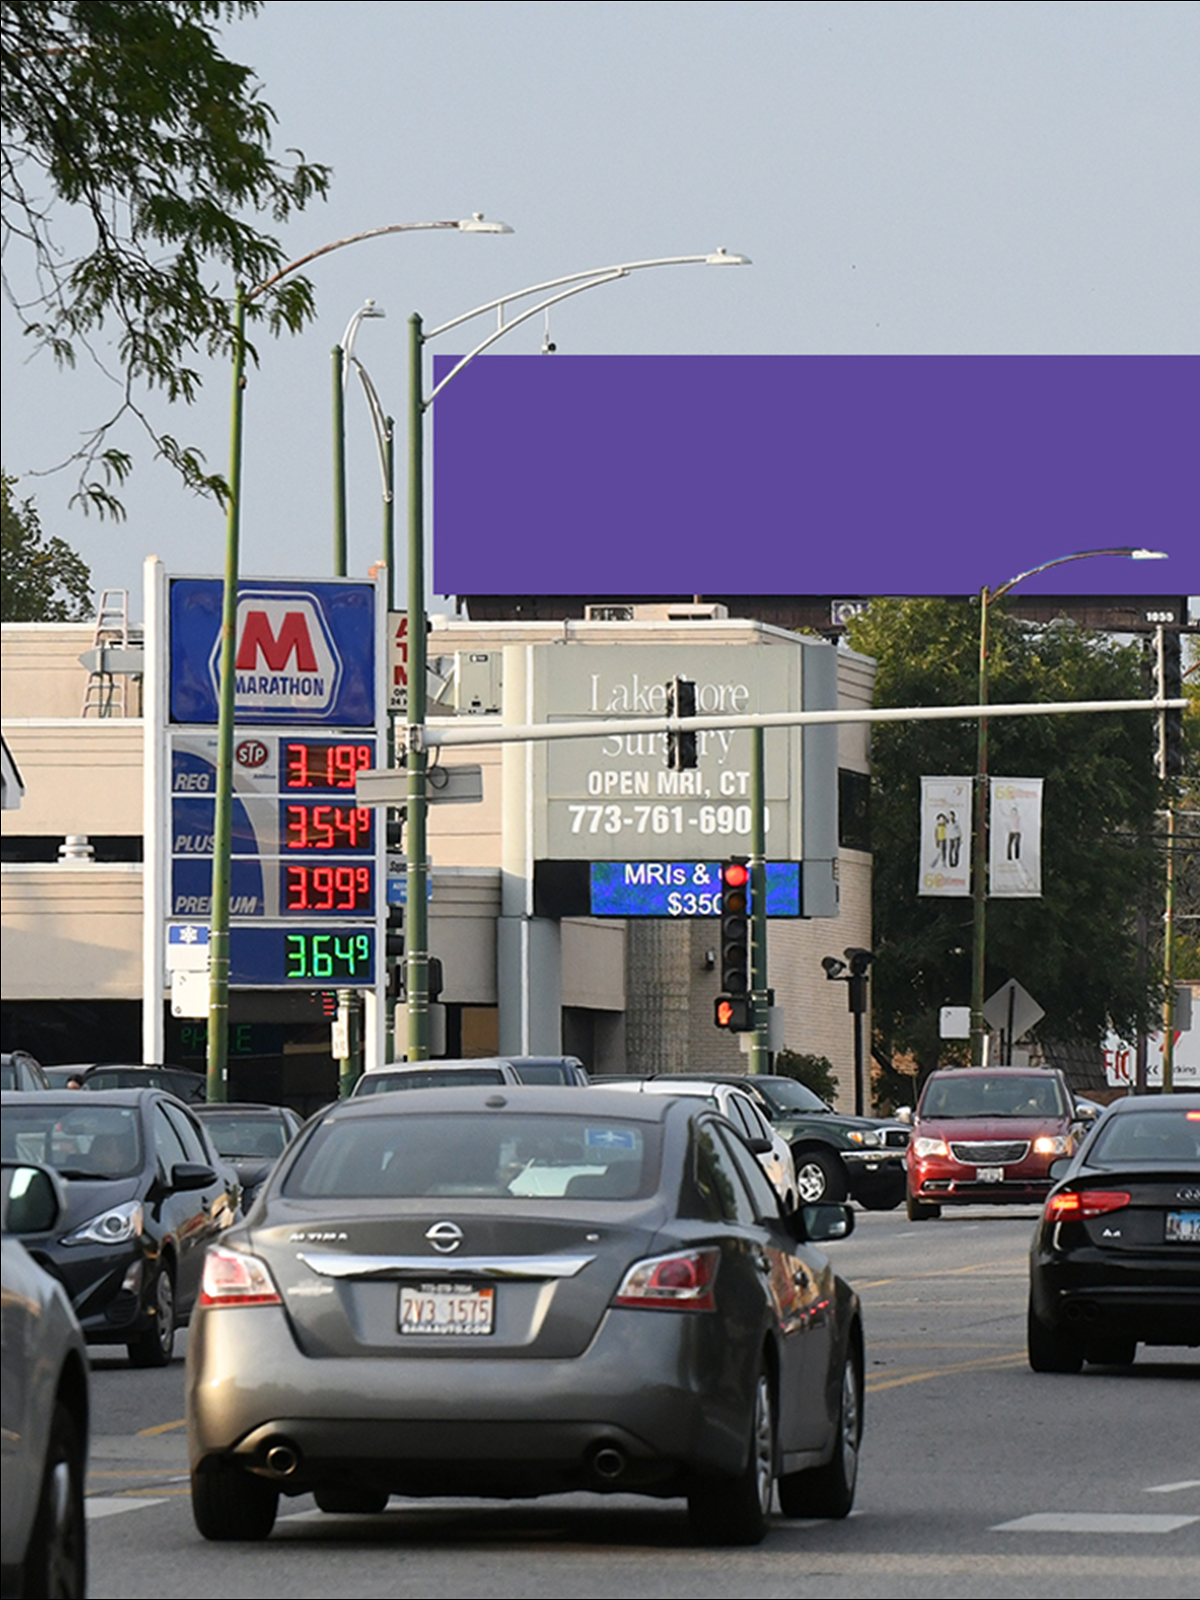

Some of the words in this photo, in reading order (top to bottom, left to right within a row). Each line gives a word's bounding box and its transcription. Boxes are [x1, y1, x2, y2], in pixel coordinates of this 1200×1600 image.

[235, 611, 318, 672] M
[236, 676, 324, 696] MARATHON
[590, 674, 749, 712] Lakeore
[240, 743, 265, 763] STP
[174, 773, 210, 791] REG
[588, 770, 649, 796] OPEN
[657, 771, 711, 800] MRI,
[719, 770, 750, 796] CT
[174, 835, 214, 852] PLUS
[625, 863, 686, 885] MRIs
[692, 863, 711, 885] &
[174, 896, 257, 914] PREUM
[447, 1299, 489, 1323] 1575
